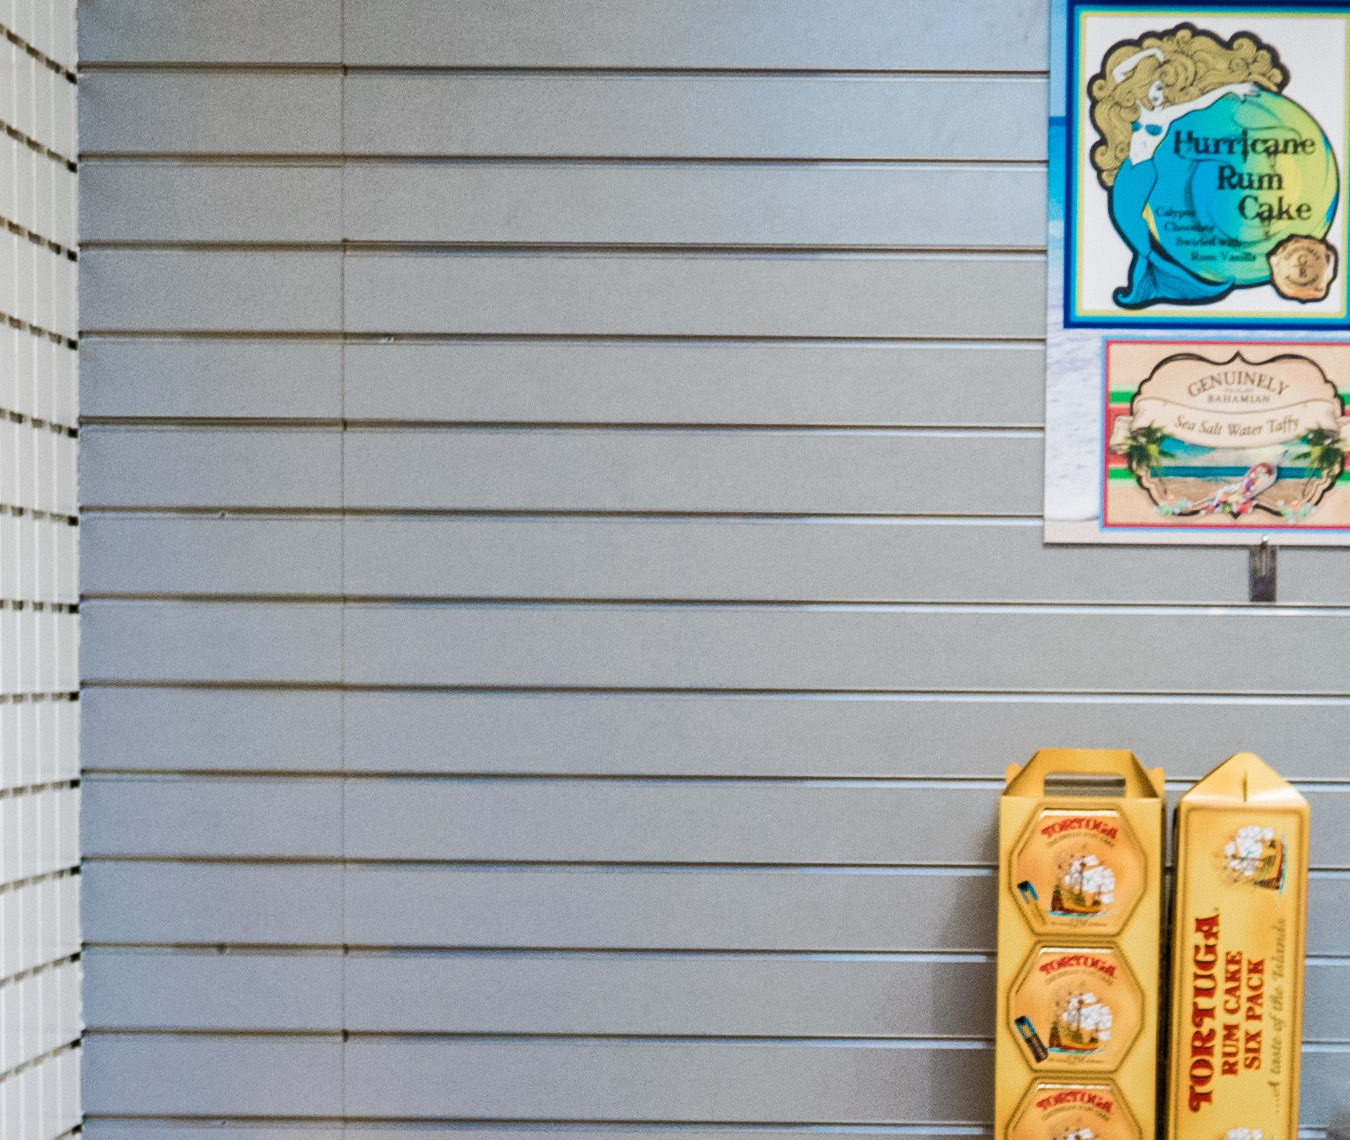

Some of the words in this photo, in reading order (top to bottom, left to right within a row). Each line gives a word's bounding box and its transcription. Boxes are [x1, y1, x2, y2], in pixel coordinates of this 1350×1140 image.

[1174, 130, 1317, 163] Hurricane
[1217, 165, 1284, 191] Rum
[1237, 195, 1313, 223] Cake
[1187, 371, 1290, 397] GENUINELY
[1207, 395, 1271, 404] BAHAMIAN
[1174, 415, 1197, 431] Sea
[1198, 420, 1223, 436] Salt
[1227, 424, 1263, 437] Water
[1267, 416, 1300, 433] Taffy
[1223, 950, 1243, 1016] CAKE
[1245, 957, 1266, 1022] PACK
[1188, 912, 1220, 1114] TORTUGA
[1221, 1023, 1241, 1077] RUM
[1243, 1028, 1263, 1071] SIX
